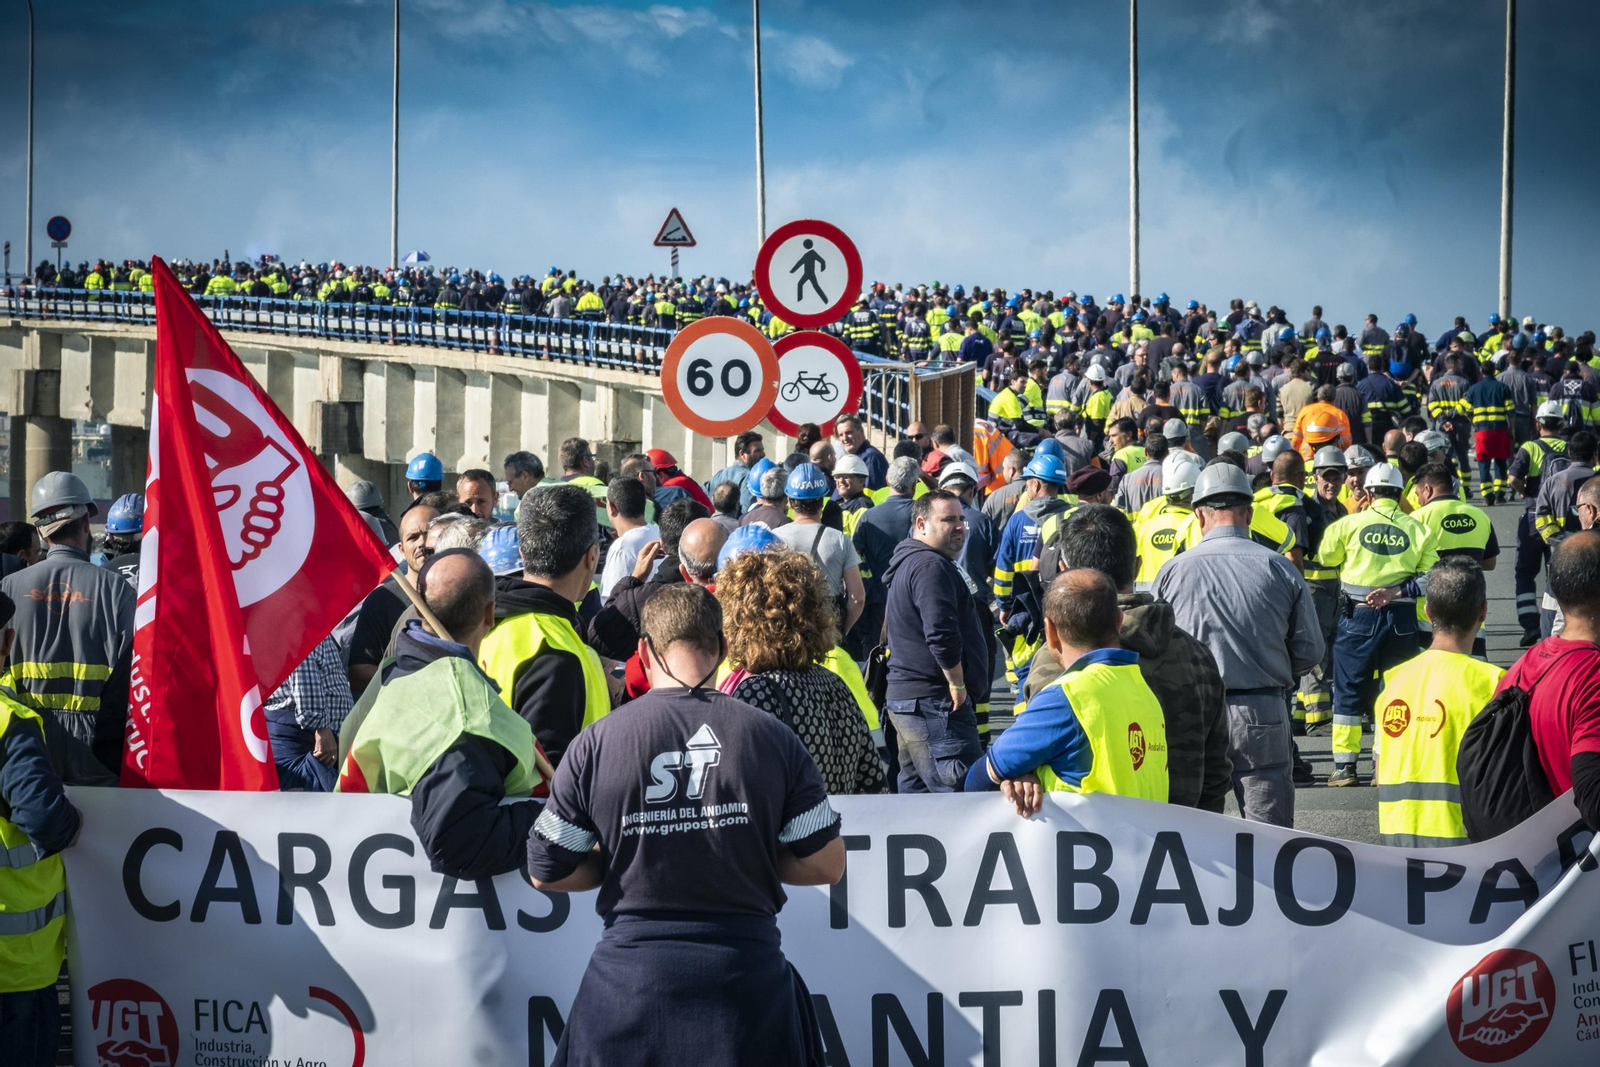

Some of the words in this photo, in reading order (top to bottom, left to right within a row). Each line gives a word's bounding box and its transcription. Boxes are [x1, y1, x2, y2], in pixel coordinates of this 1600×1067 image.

[686, 358, 752, 397] 60
[1443, 518, 1475, 529] COASA
[1363, 532, 1405, 548] COASA
[644, 748, 722, 804] ST
[622, 808, 677, 827] INGENIERÍA
[679, 807, 698, 819] DEL
[700, 802, 748, 818] ANDAMIO
[622, 816, 749, 836] www.grupost.com
[1461, 959, 1539, 1023] UGT
[194, 998, 268, 1035] FICA
[1218, 988, 1289, 1067] Y
[195, 1038, 256, 1055] Industria,
[195, 1053, 279, 1067] Construcción
